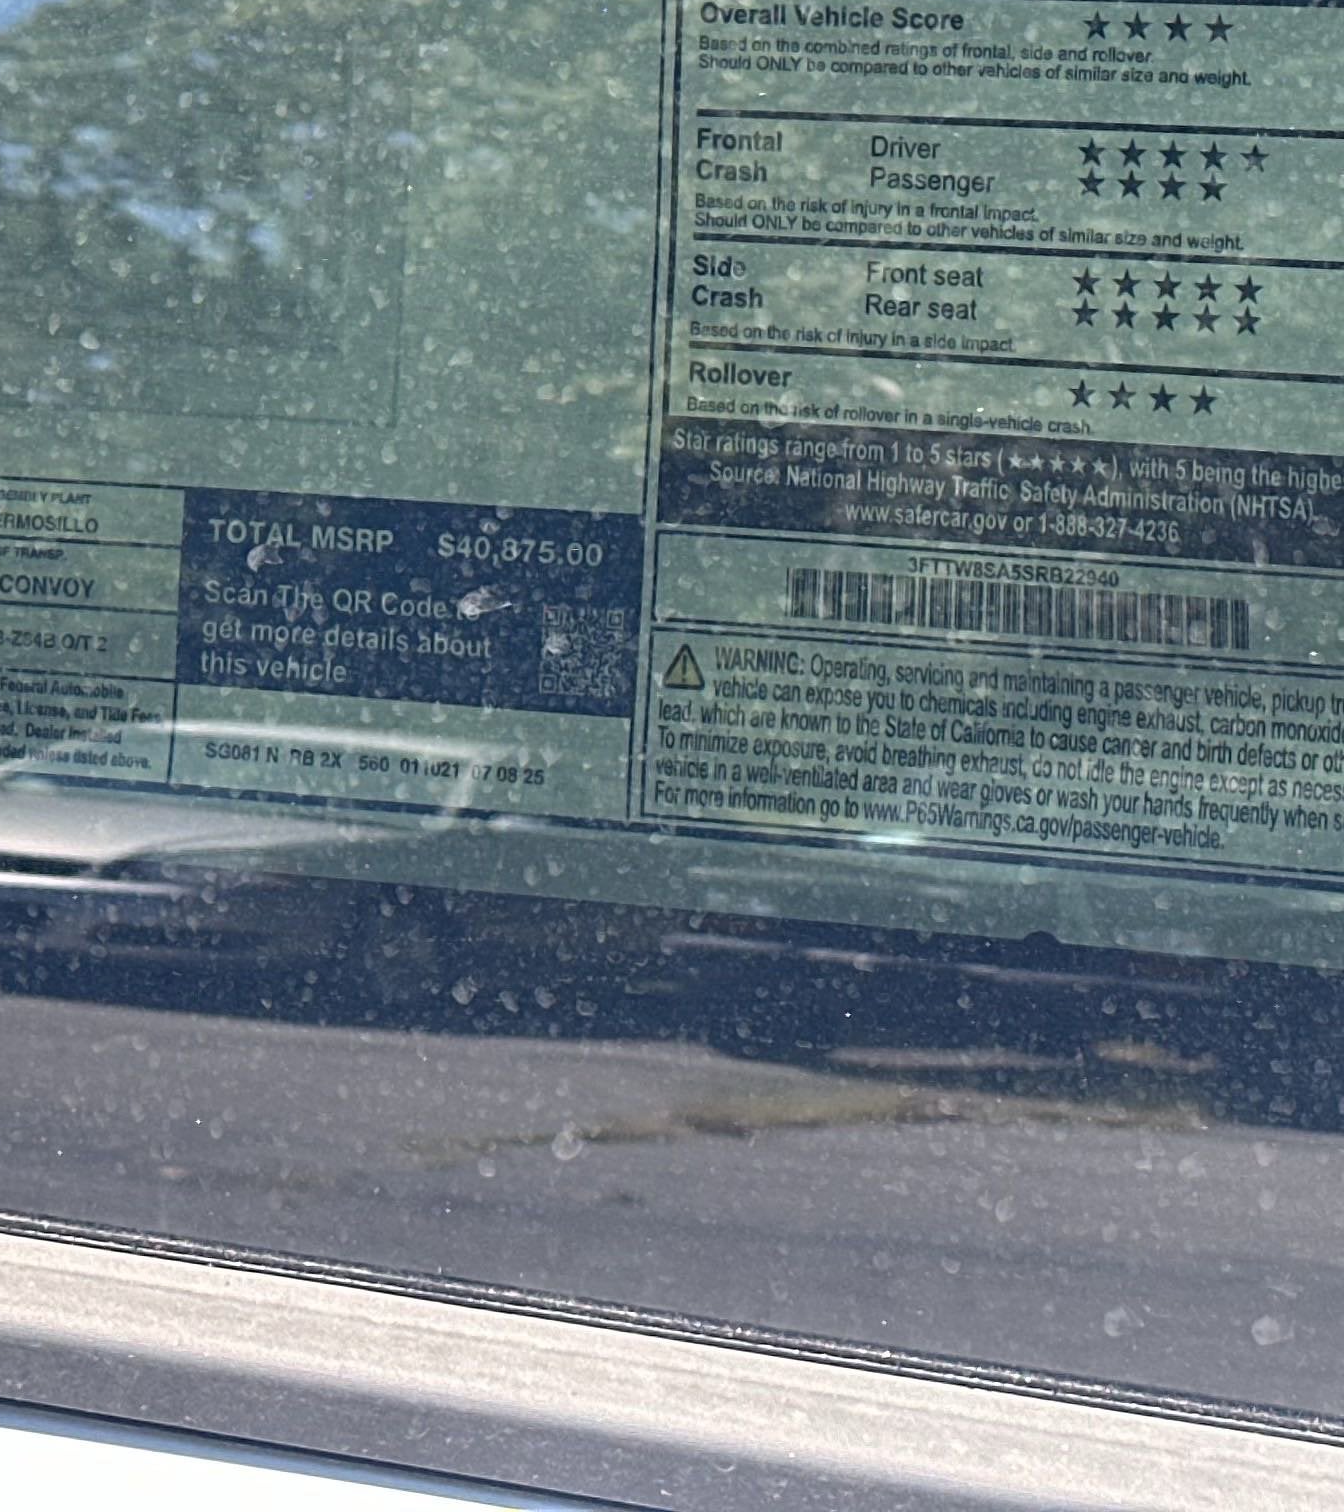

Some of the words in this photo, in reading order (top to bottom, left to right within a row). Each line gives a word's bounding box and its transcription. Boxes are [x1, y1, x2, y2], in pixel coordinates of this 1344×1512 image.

[700, 2, 785, 25] Overall
[795, 5, 883, 29] Vehicle
[892, 7, 964, 30] Score
[697, 129, 782, 152] Frontal
[871, 136, 940, 159] Driver
[696, 159, 767, 182] Crash
[870, 167, 995, 196] Passenger
[693, 255, 746, 277] Side
[867, 261, 926, 285] Front
[934, 265, 983, 287] seat
[692, 286, 763, 309] Crash
[865, 294, 920, 317] Rear
[928, 297, 977, 320] seat
[689, 362, 792, 387] Rollover
[786, 467, 861, 490] National
[866, 472, 946, 500] Highway
[952, 476, 1008, 500] Traffic
[1020, 480, 1078, 506] Safety
[1084, 486, 1226, 516] Administration
[845, 503, 1007, 533] www.safercar.gov
[1013, 514, 1033, 531] or
[1038, 512, 1179, 544] 1-888-327-4236
[209, 519, 301, 550] TOTAL
[311, 524, 394, 553] MSRP
[438, 532, 603, 568] $40,875.00
[0, 574, 95, 599] CONVOY
[204, 581, 267, 605] Scan
[278, 585, 322, 609] The
[334, 588, 372, 613] QR
[381, 593, 448, 620] Code
[202, 620, 237, 642] get
[251, 623, 317, 647] more
[325, 627, 408, 653] details
[417, 633, 491, 658] about
[201, 651, 247, 675] this
[257, 655, 347, 682] vehicle
[715, 647, 806, 675] WARNING:
